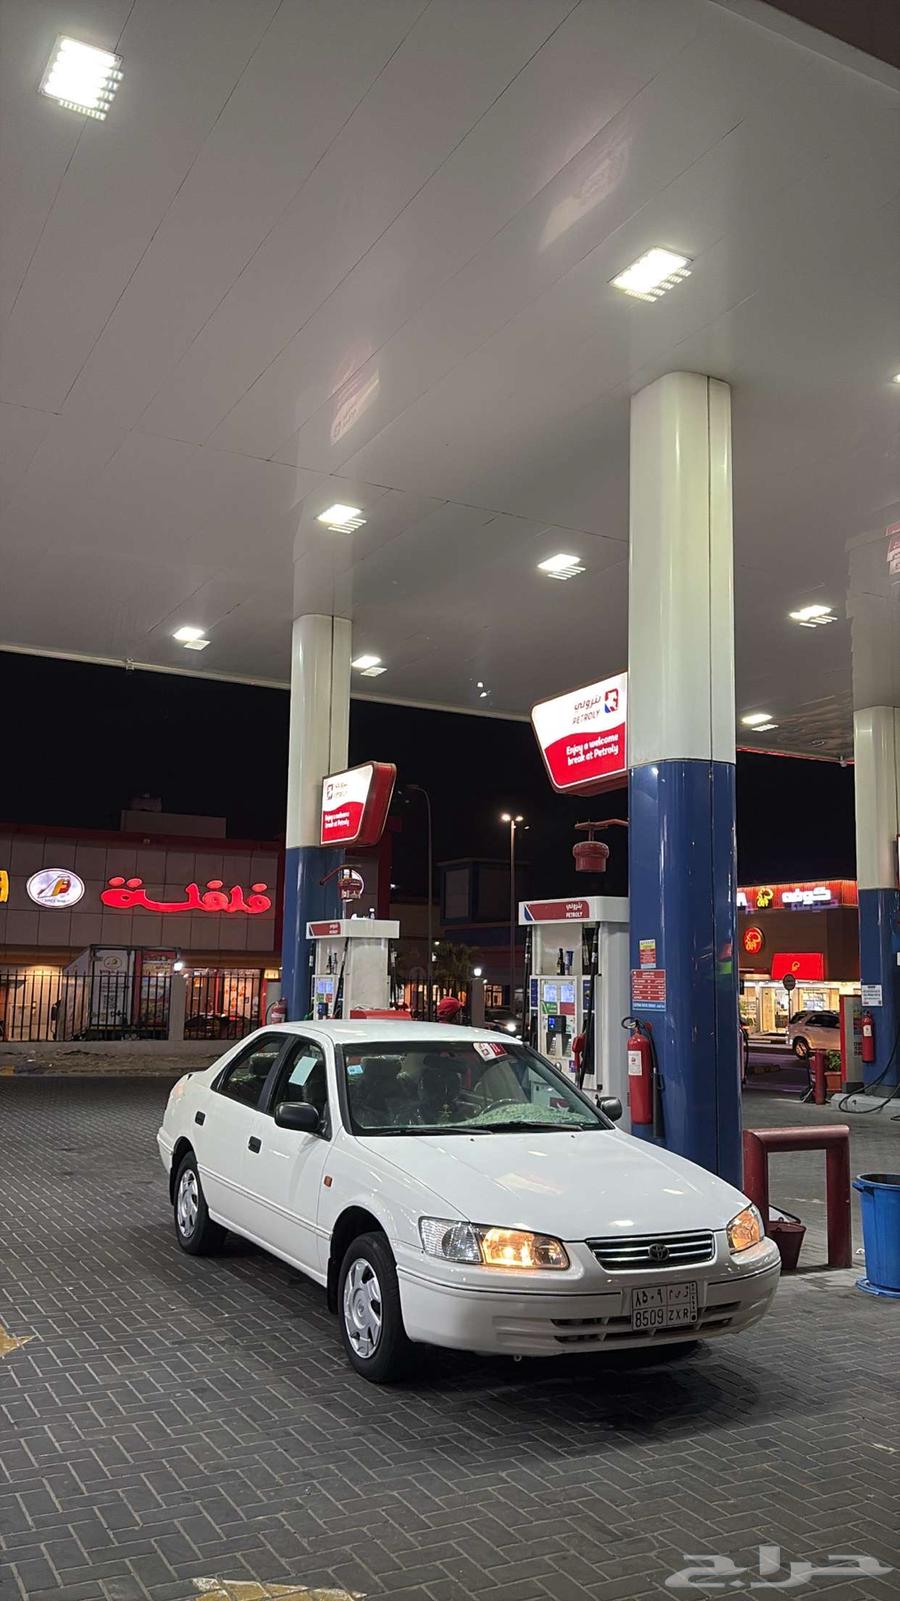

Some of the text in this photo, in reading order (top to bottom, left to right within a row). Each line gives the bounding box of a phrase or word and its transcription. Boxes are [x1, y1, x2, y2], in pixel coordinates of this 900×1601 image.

[572, 710, 600, 724] PETROLY
[566, 744, 583, 757] Enjoy
[589, 734, 618, 748] welcome
[568, 744, 618, 766] break at Petroly
[101, 876, 272, 914] فلفلة
[635, 1309, 664, 1328] 8509
